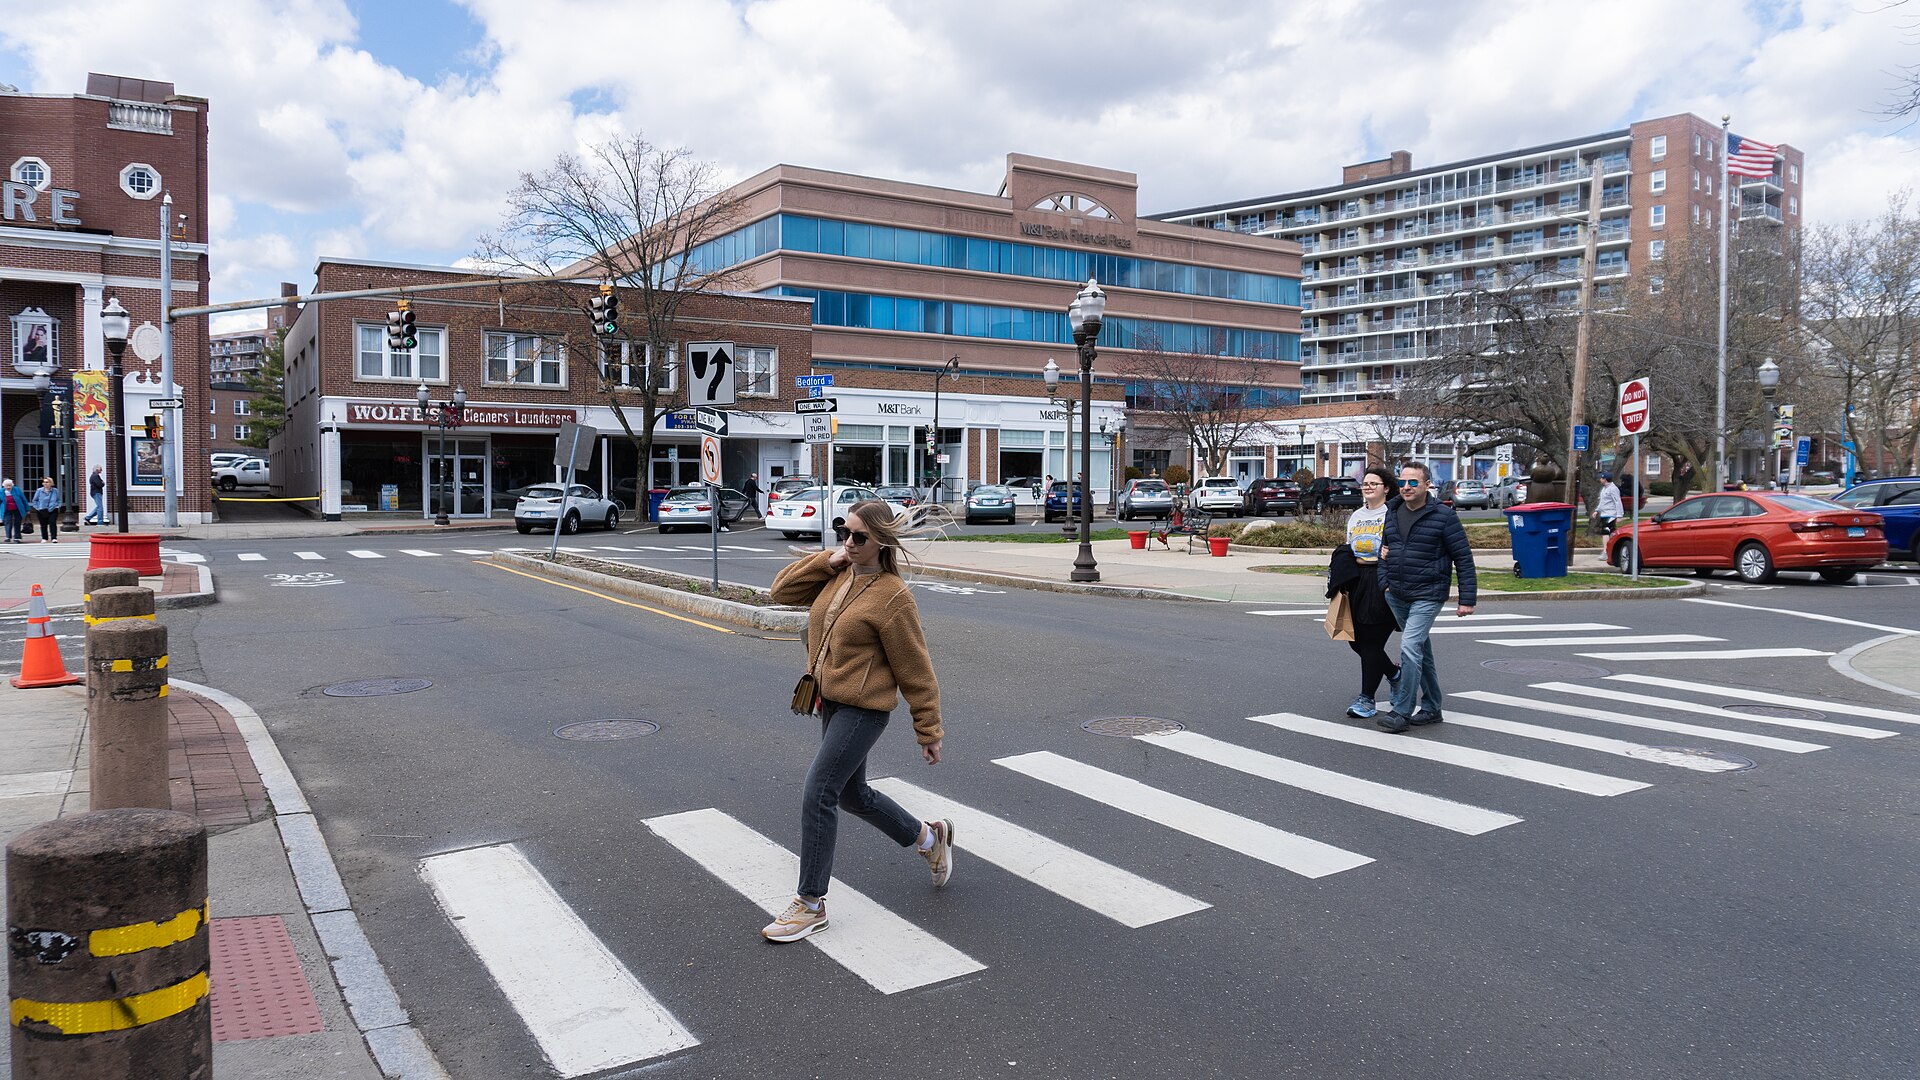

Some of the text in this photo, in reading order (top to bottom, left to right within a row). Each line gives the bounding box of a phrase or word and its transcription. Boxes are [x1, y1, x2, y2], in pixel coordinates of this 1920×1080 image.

[1020, 221, 1131, 249] M&T Bank Financial Plaza
[797, 376, 825, 386] Bedford
[1624, 389, 1645, 402] DO NOT
[877, 402, 921, 415] M&T Bank
[463, 408, 509, 423] Cleaners
[515, 410, 572, 425] Launderers
[1039, 410, 1057, 420] M&T
[1626, 412, 1643, 424] ENTER
[1497, 453, 1511, 462] 25
